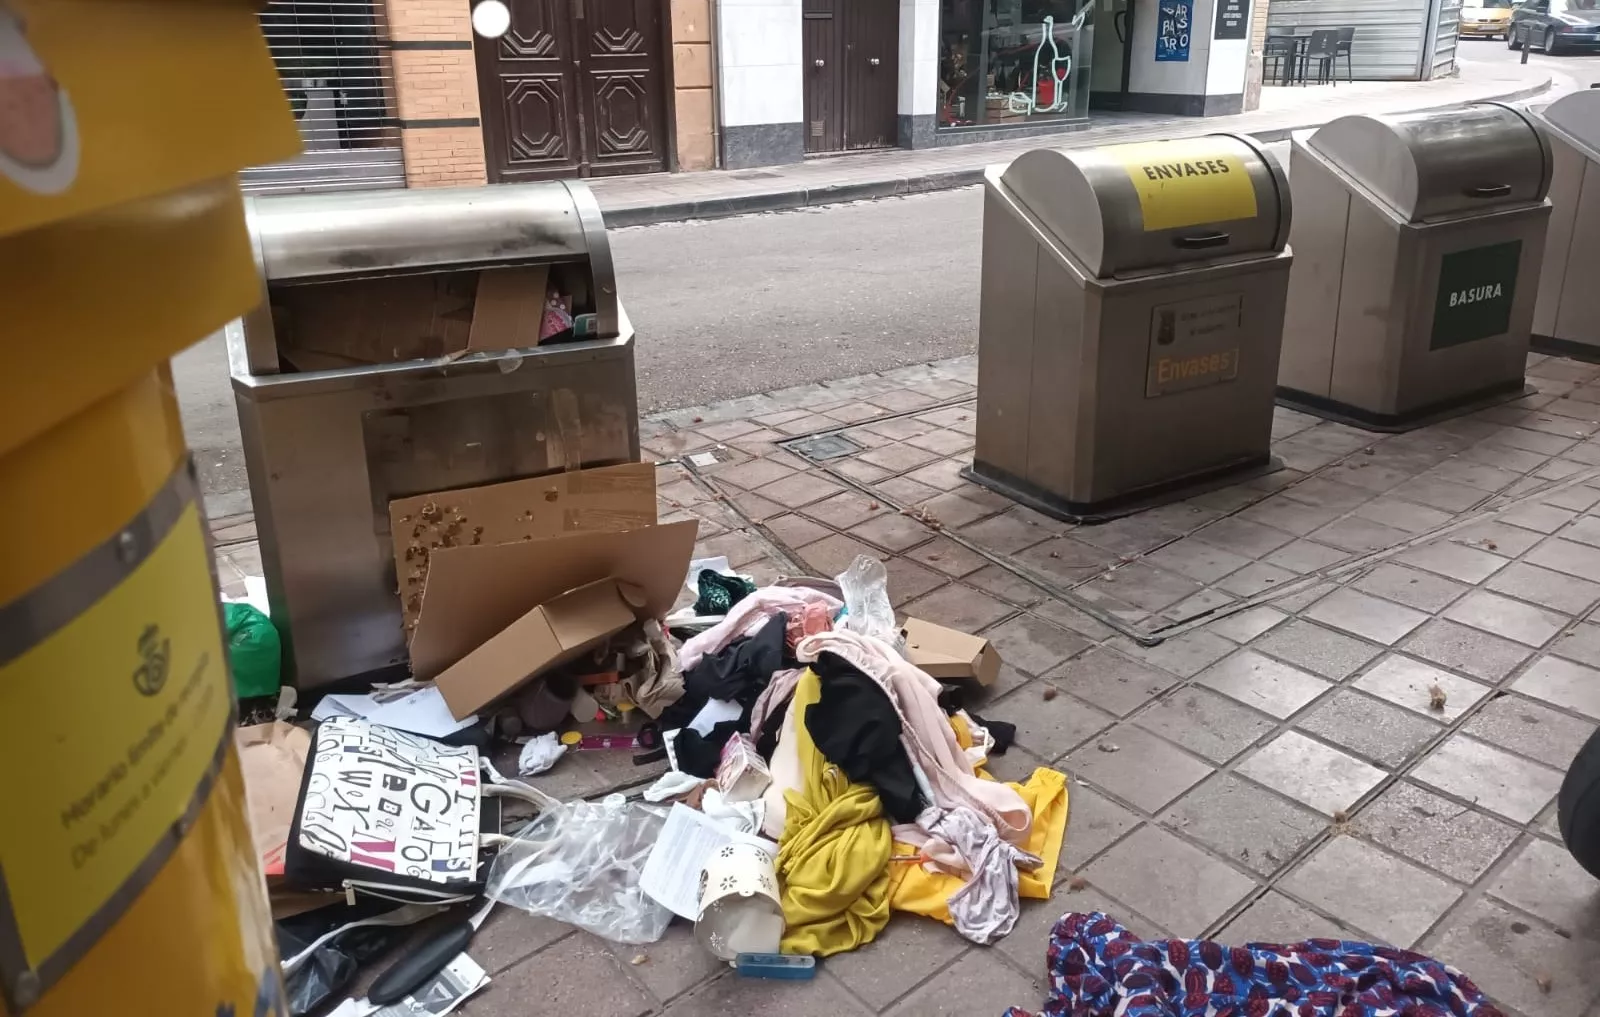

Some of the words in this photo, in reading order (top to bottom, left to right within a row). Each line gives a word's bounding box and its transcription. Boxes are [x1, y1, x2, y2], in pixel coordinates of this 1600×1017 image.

[1143, 159, 1229, 181] ENVASES
[1449, 283, 1502, 307] BASURA
[1157, 352, 1231, 384] Envases
